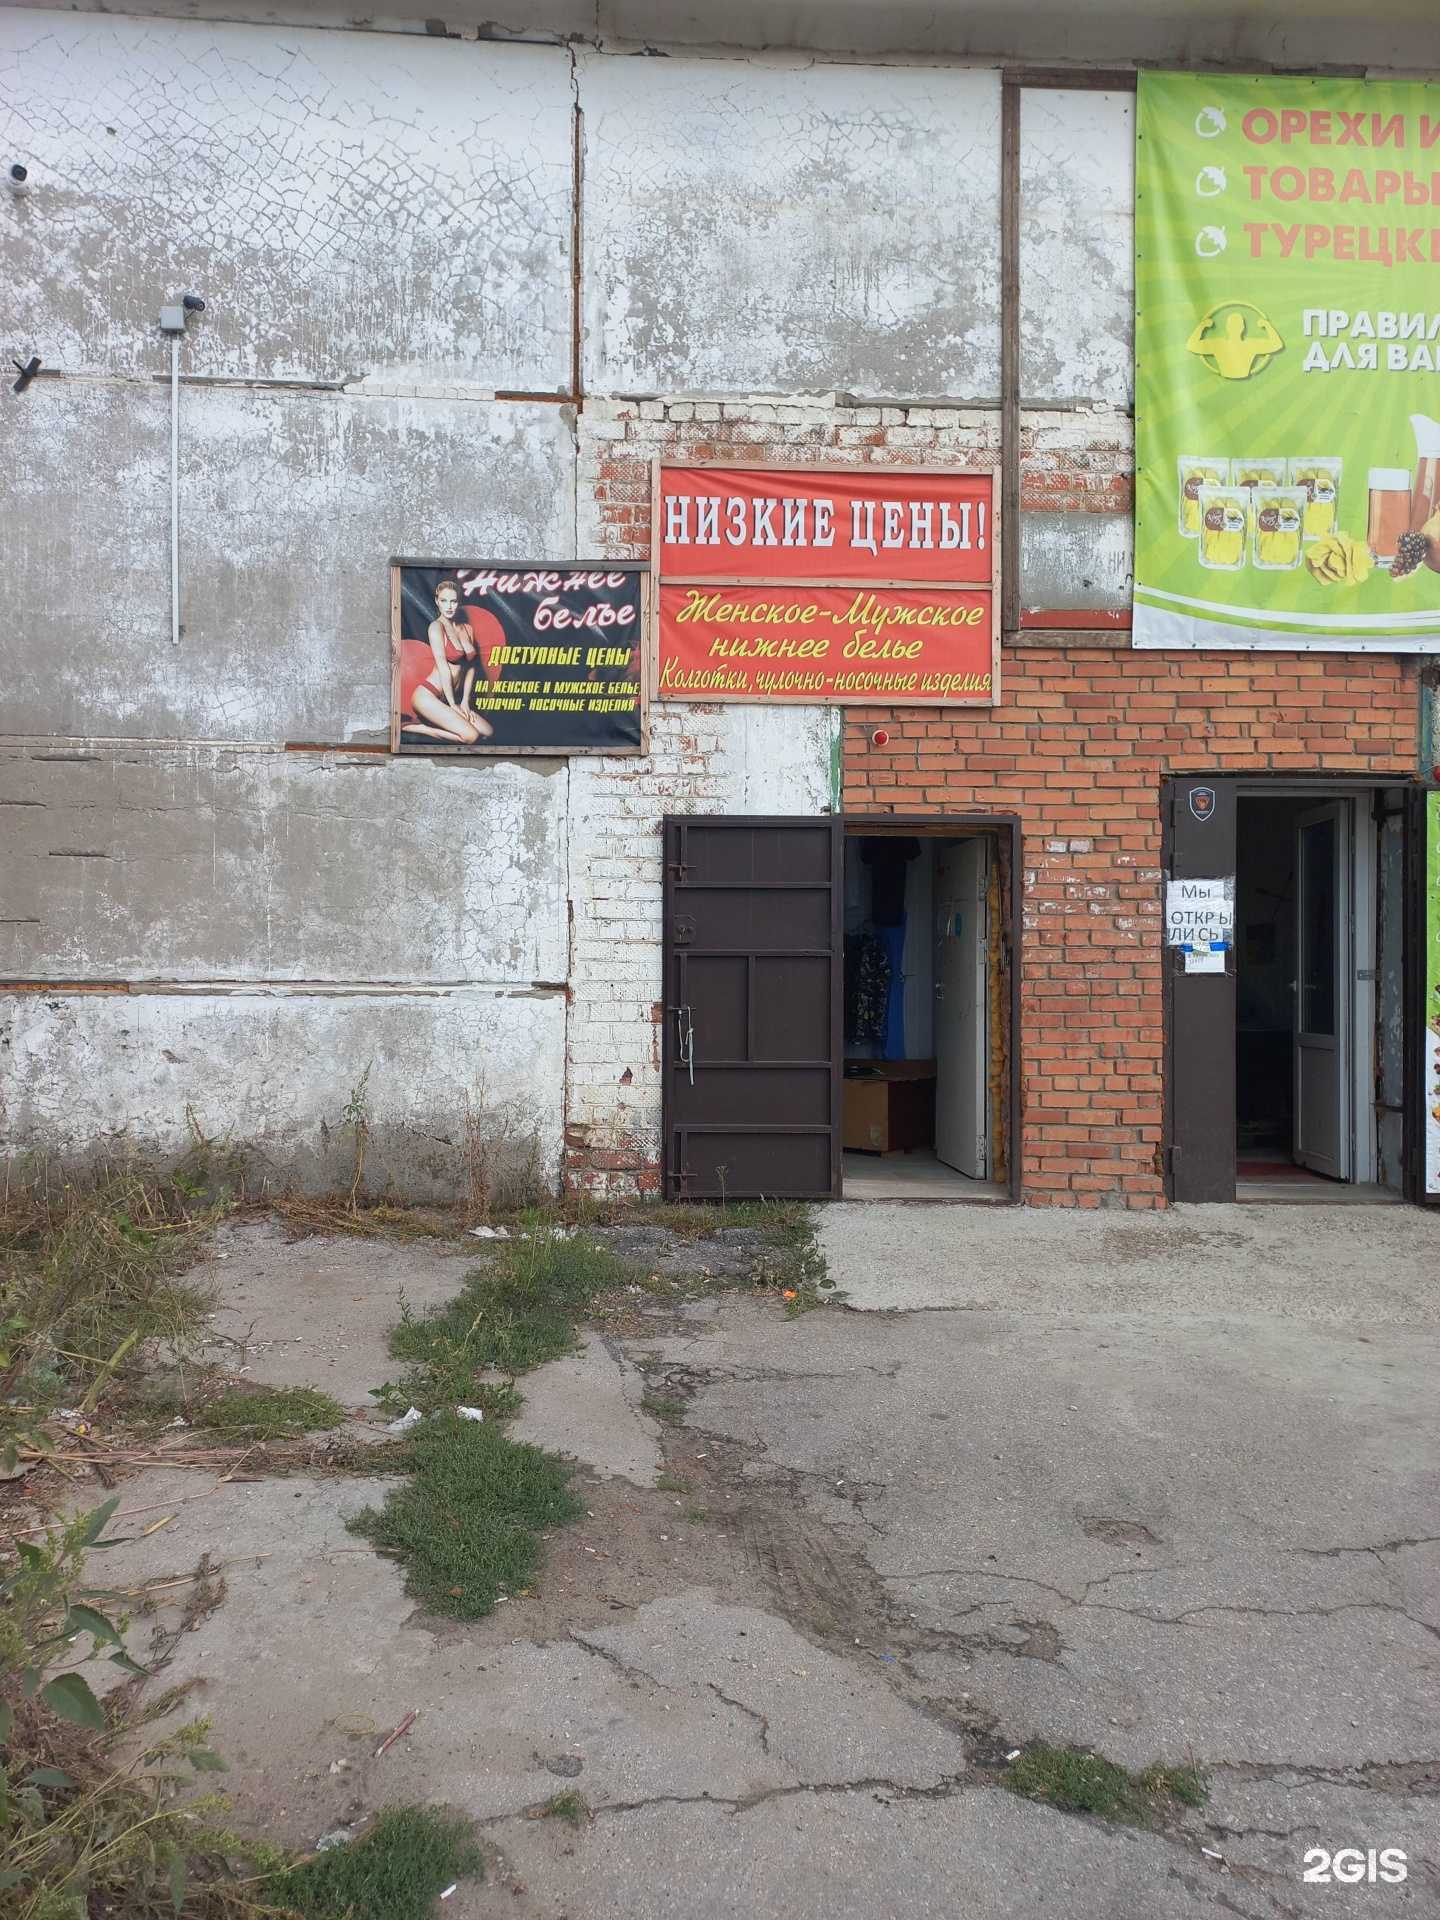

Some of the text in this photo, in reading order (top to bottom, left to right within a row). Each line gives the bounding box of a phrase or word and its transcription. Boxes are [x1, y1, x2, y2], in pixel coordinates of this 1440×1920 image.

[1241, 107, 1405, 149] ОРЕХИ
[1242, 165, 1440, 206] ТОВАРЫ
[1303, 341, 1440, 372] ДЛЯ ВА
[664, 495, 986, 556] НИЗКИЕ ЦЕНЫ!
[675, 589, 985, 635] Женское-Мужское
[488, 646, 631, 669] ДОСТУПНЫЕ ЦЕНЫ
[708, 628, 924, 660] нижнее белье
[475, 680, 490, 693] НА
[492, 680, 541, 694] ЖЕНСКОЕ
[543, 681, 551, 694] И
[553, 681, 605, 695] МУЖСКОЕ
[659, 656, 992, 698] Колготки, чулочно-носочные изделия
[528, 699, 585, 712] НОСОЧНЫЕ
[587, 700, 636, 714] ИЗДЕЛИЯ
[1181, 884, 1211, 899] Мы
